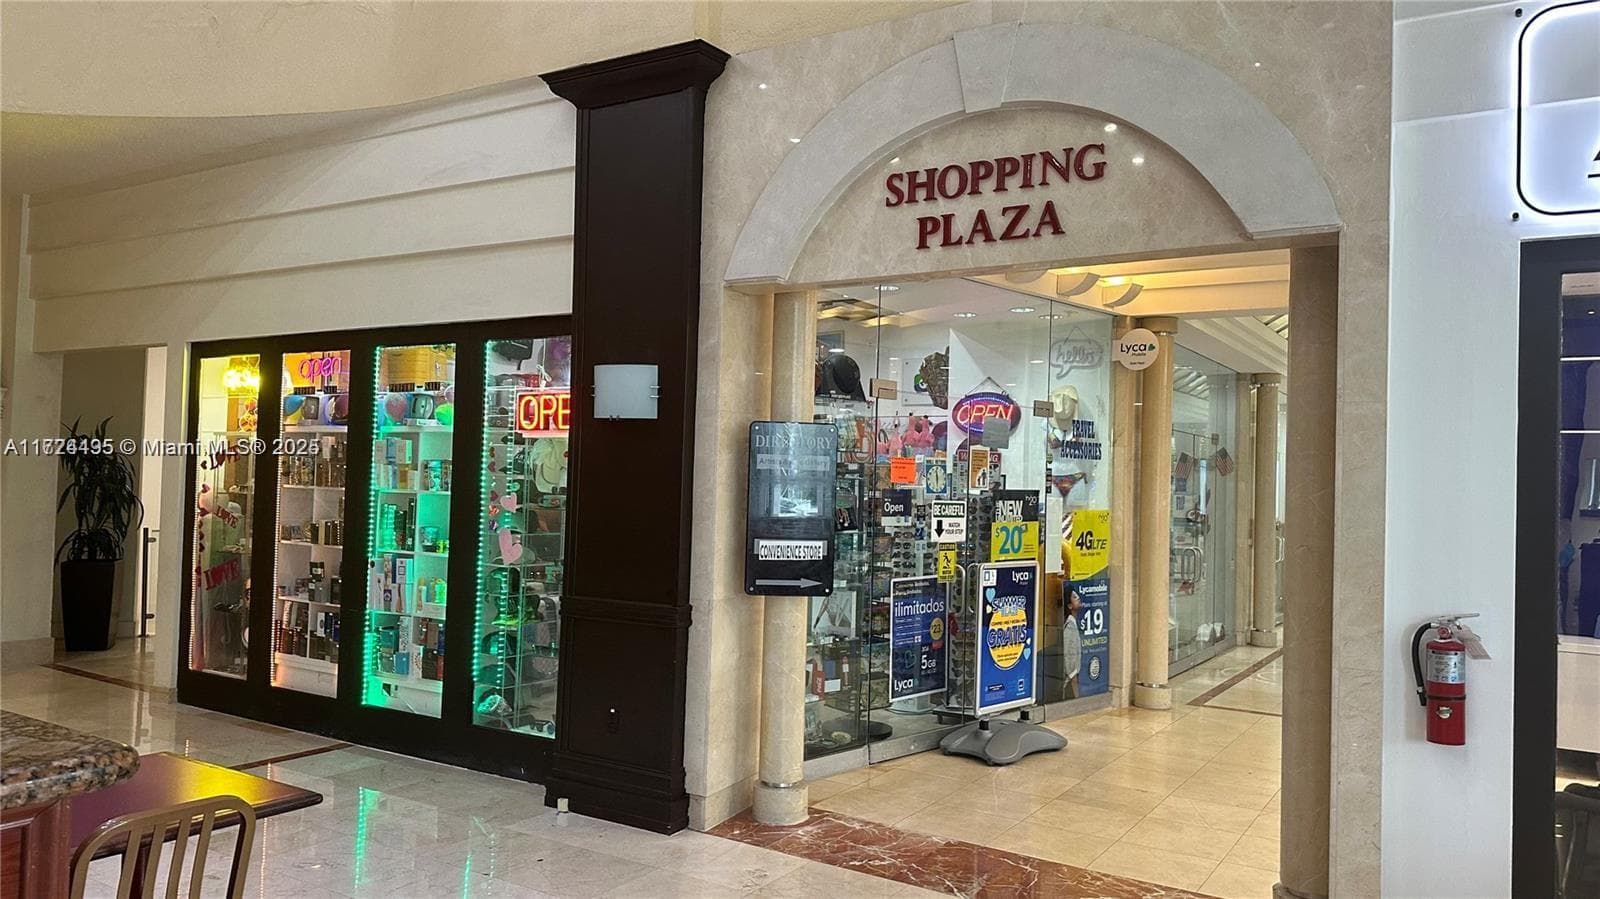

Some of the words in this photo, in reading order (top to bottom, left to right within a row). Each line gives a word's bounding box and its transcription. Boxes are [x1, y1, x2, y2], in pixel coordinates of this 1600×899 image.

[886, 143, 1107, 207] SHOPPING
[916, 200, 1065, 249] PLAZA
[1120, 343, 1147, 354] Lyca
[300, 357, 341, 383] open
[520, 395, 571, 430] OPE
[957, 404, 1014, 424] OPEN
[884, 502, 904, 514] Open
[933, 504, 941, 516] BE
[941, 504, 965, 516] CAREFUL
[999, 500, 1023, 516] NEW
[760, 545, 801, 559] CONVENIENCE
[803, 545, 822, 559] STORE
[1012, 571, 1029, 583] Lyca
[895, 598, 944, 617] ilimitados
[987, 624, 1027, 648] GRATIS
[894, 678, 914, 692] Lyca
